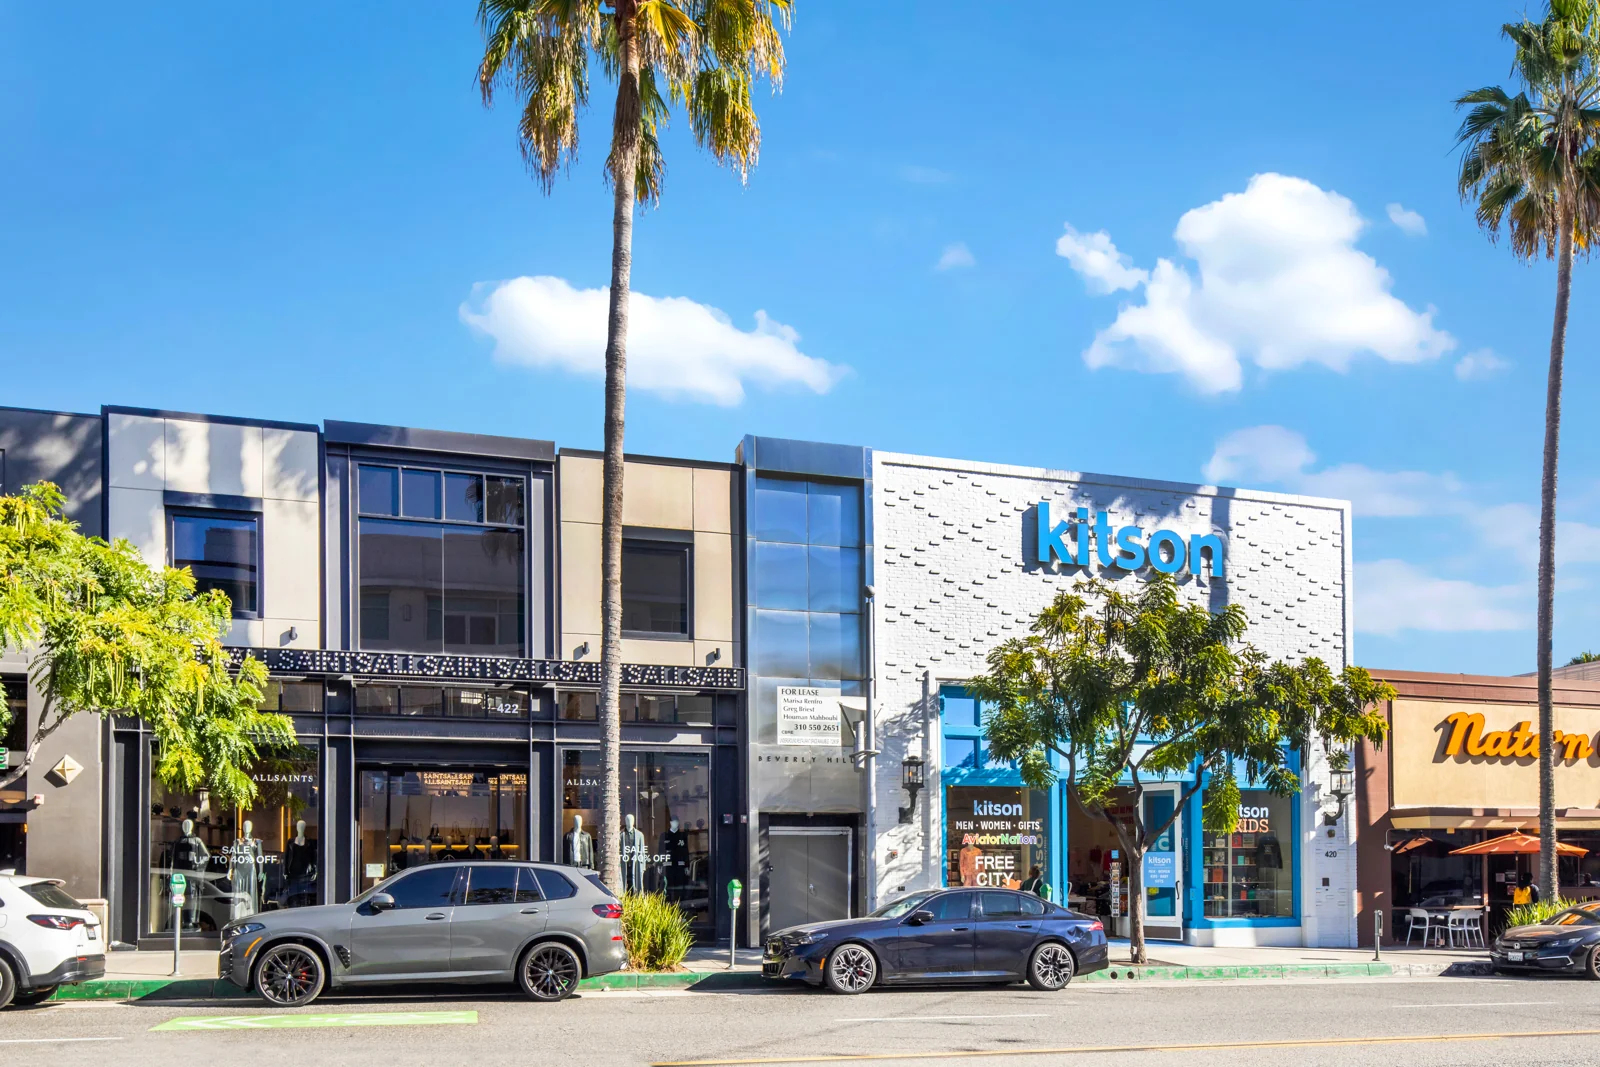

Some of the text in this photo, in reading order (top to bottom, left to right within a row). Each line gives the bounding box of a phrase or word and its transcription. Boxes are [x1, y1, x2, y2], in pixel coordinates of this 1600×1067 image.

[1038, 502, 1223, 577] kitson
[496, 704, 518, 714] 422
[252, 774, 313, 782] ALLSAINTS
[974, 800, 1022, 816] kitson
[956, 821, 1040, 830] MEN WOMEN GIFTS
[962, 833, 1037, 845] AviatorNation
[222, 846, 250, 854] SALE
[212, 856, 227, 864] TO
[230, 856, 255, 864] 40%
[256, 855, 277, 863] OFF
[975, 856, 1014, 869] FREE
[976, 872, 1014, 886] CITY
